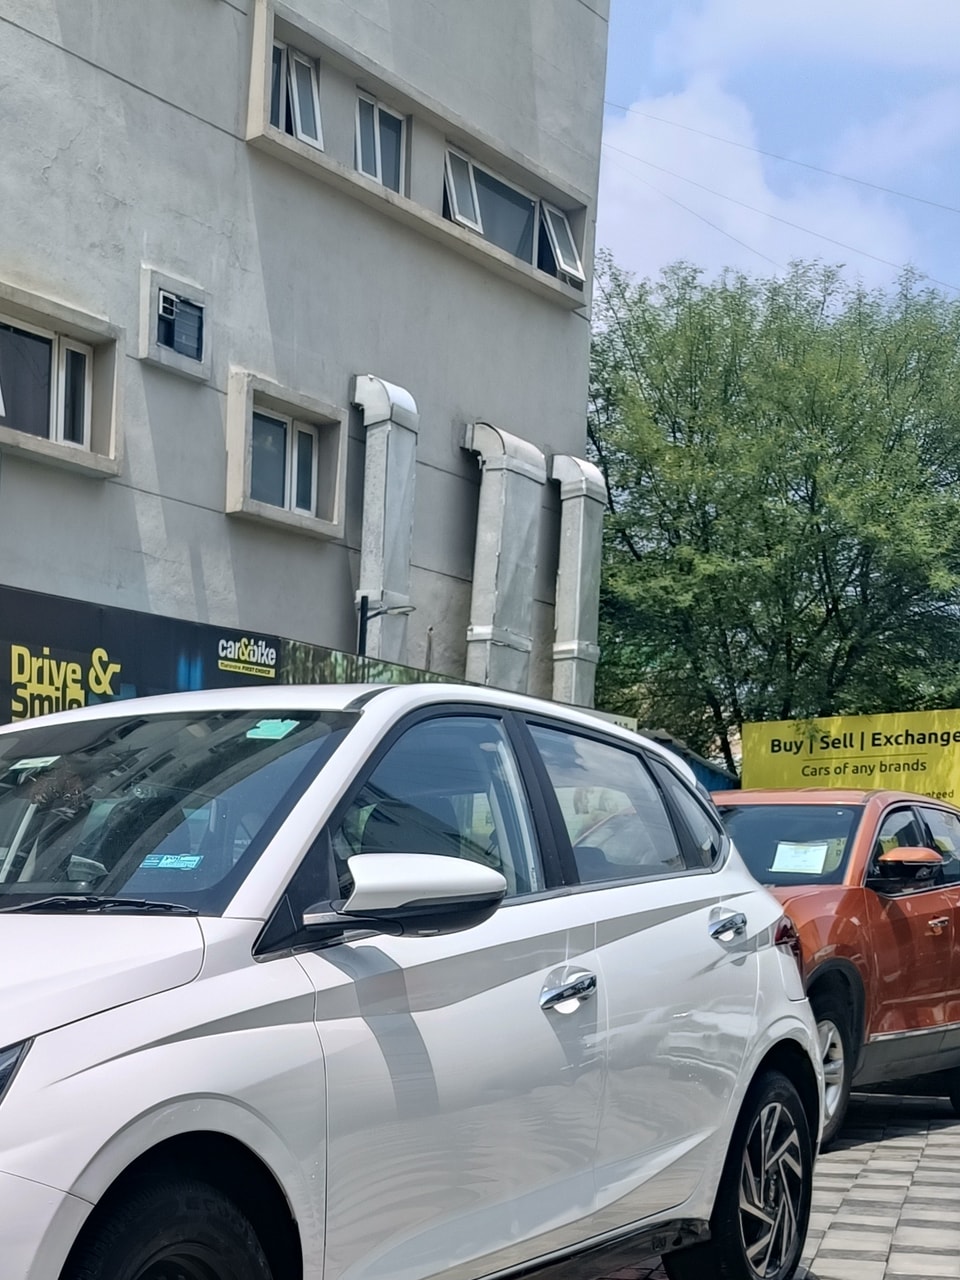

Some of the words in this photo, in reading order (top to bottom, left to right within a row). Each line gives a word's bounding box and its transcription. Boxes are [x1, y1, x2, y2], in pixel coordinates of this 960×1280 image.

[218, 637, 277, 666] car&bike
[11, 644, 82, 690] Drive
[88, 647, 121, 695] &
[770, 738, 804, 755] Buy
[820, 732, 854, 750] Sell
[871, 729, 960, 747] Exchange
[801, 764, 830, 777] Cars
[834, 762, 850, 775] of
[851, 763, 876, 776] any
[879, 759, 928, 773] brands
